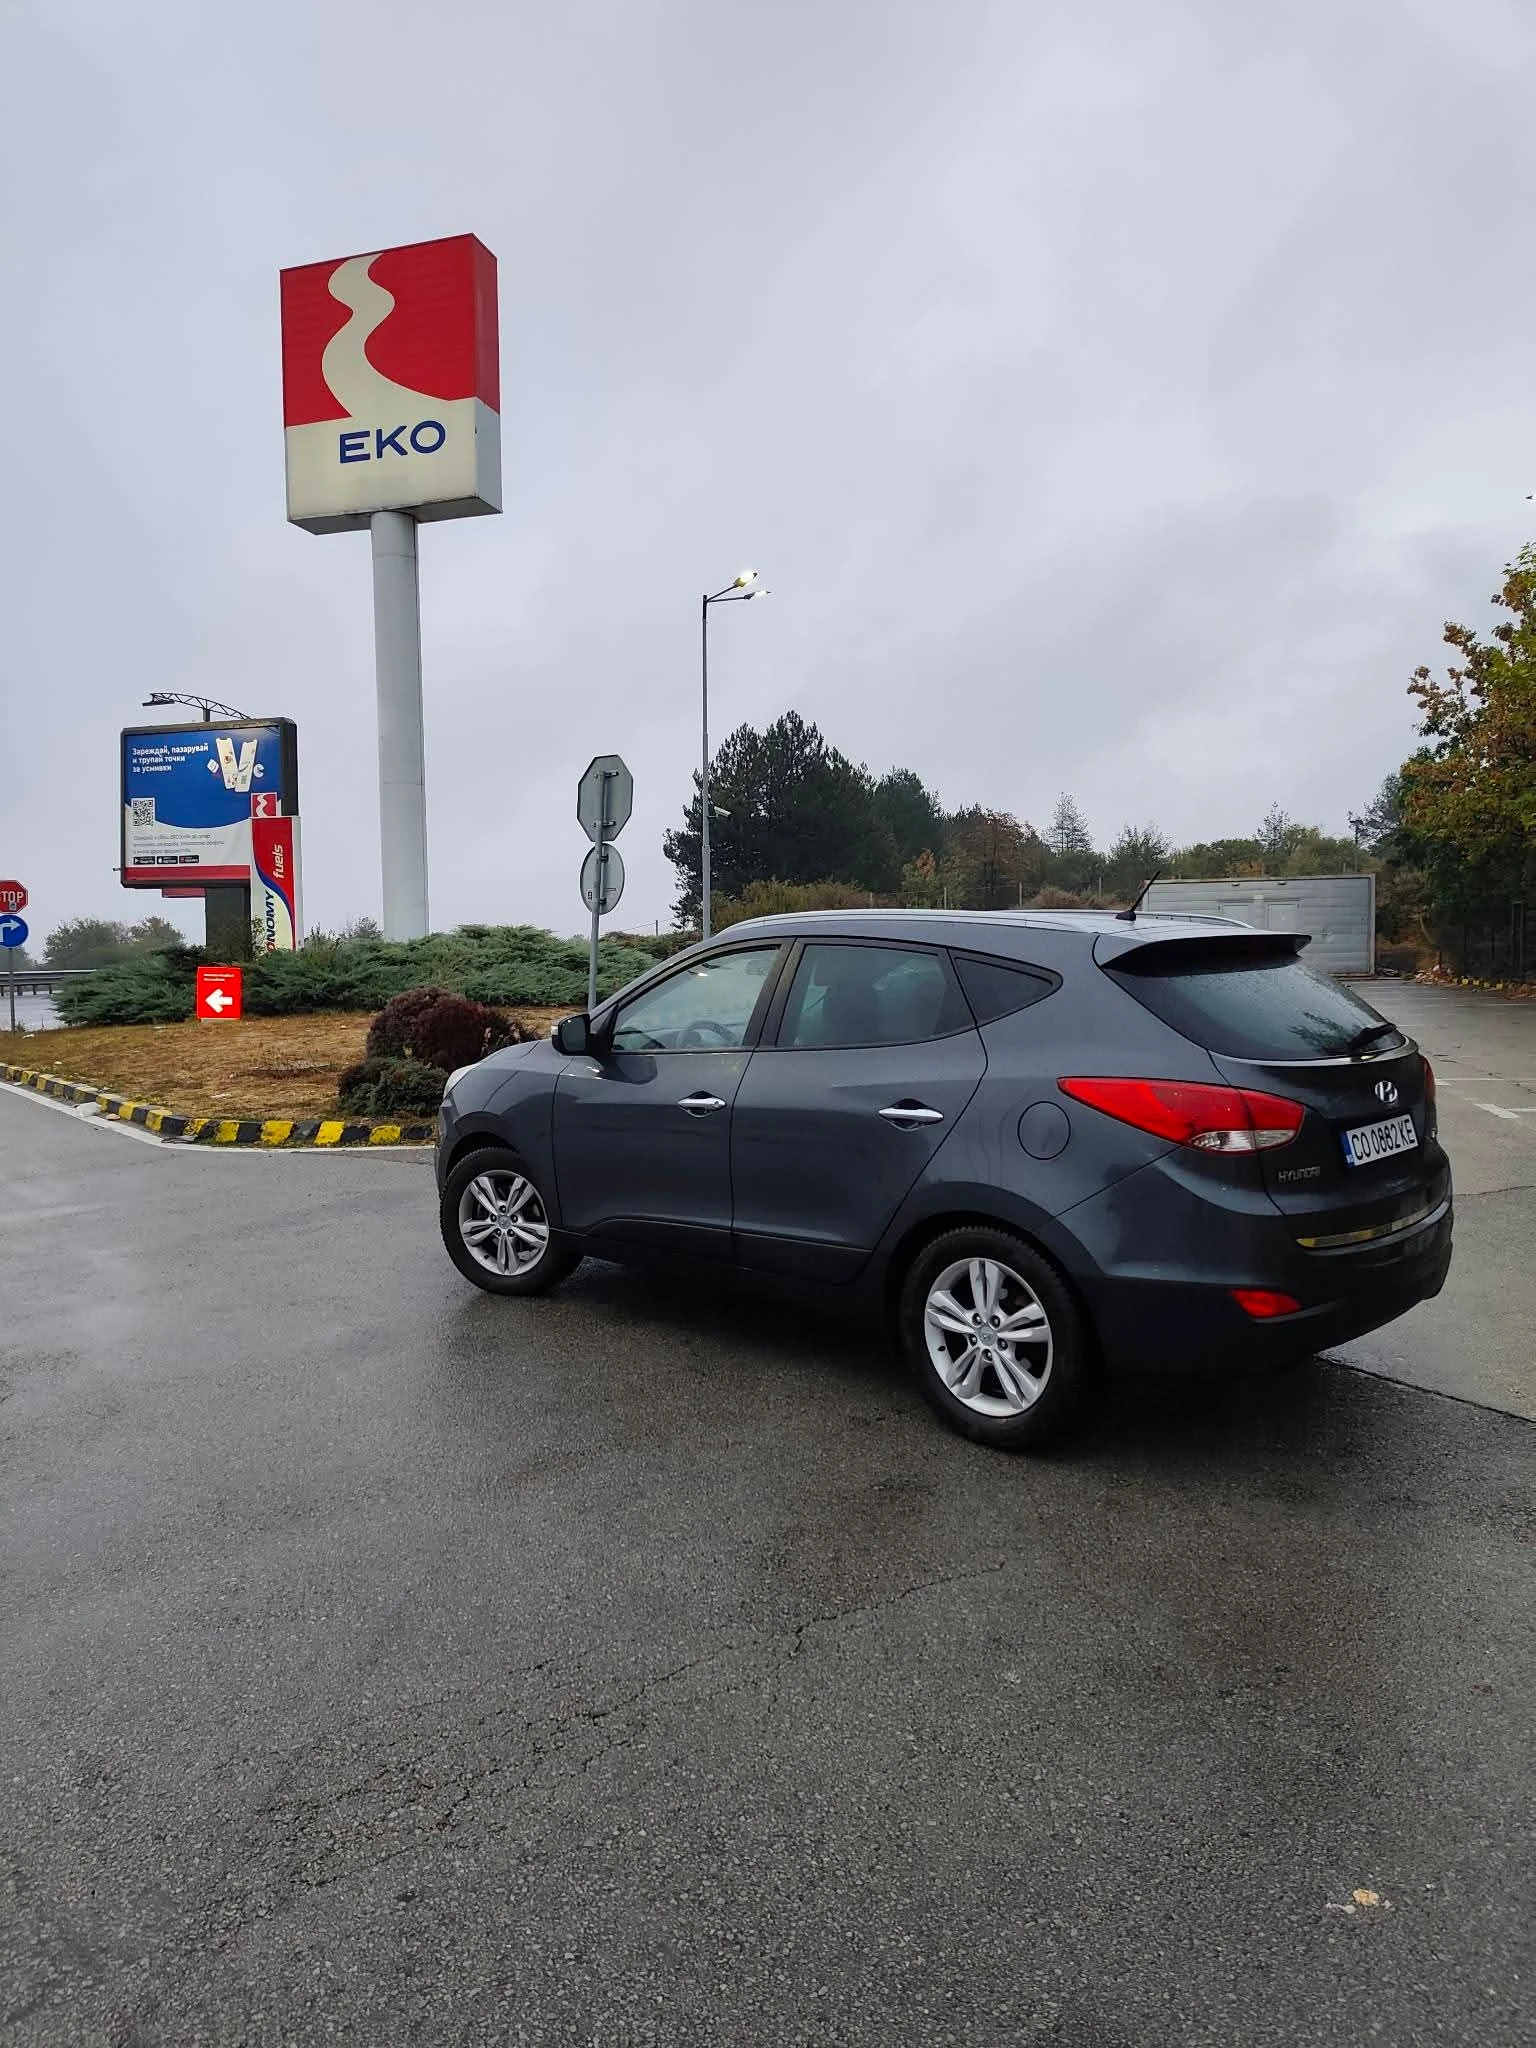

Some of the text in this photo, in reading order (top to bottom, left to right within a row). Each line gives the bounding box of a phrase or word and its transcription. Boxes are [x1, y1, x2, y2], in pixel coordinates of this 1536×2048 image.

[340, 420, 446, 464] EKO
[132, 743, 209, 756] Зареждай, пазарувай
[139, 755, 163, 765] трупай
[164, 755, 186, 763] точки
[272, 844, 285, 879] fuels
[0, 891, 24, 903] TOP
